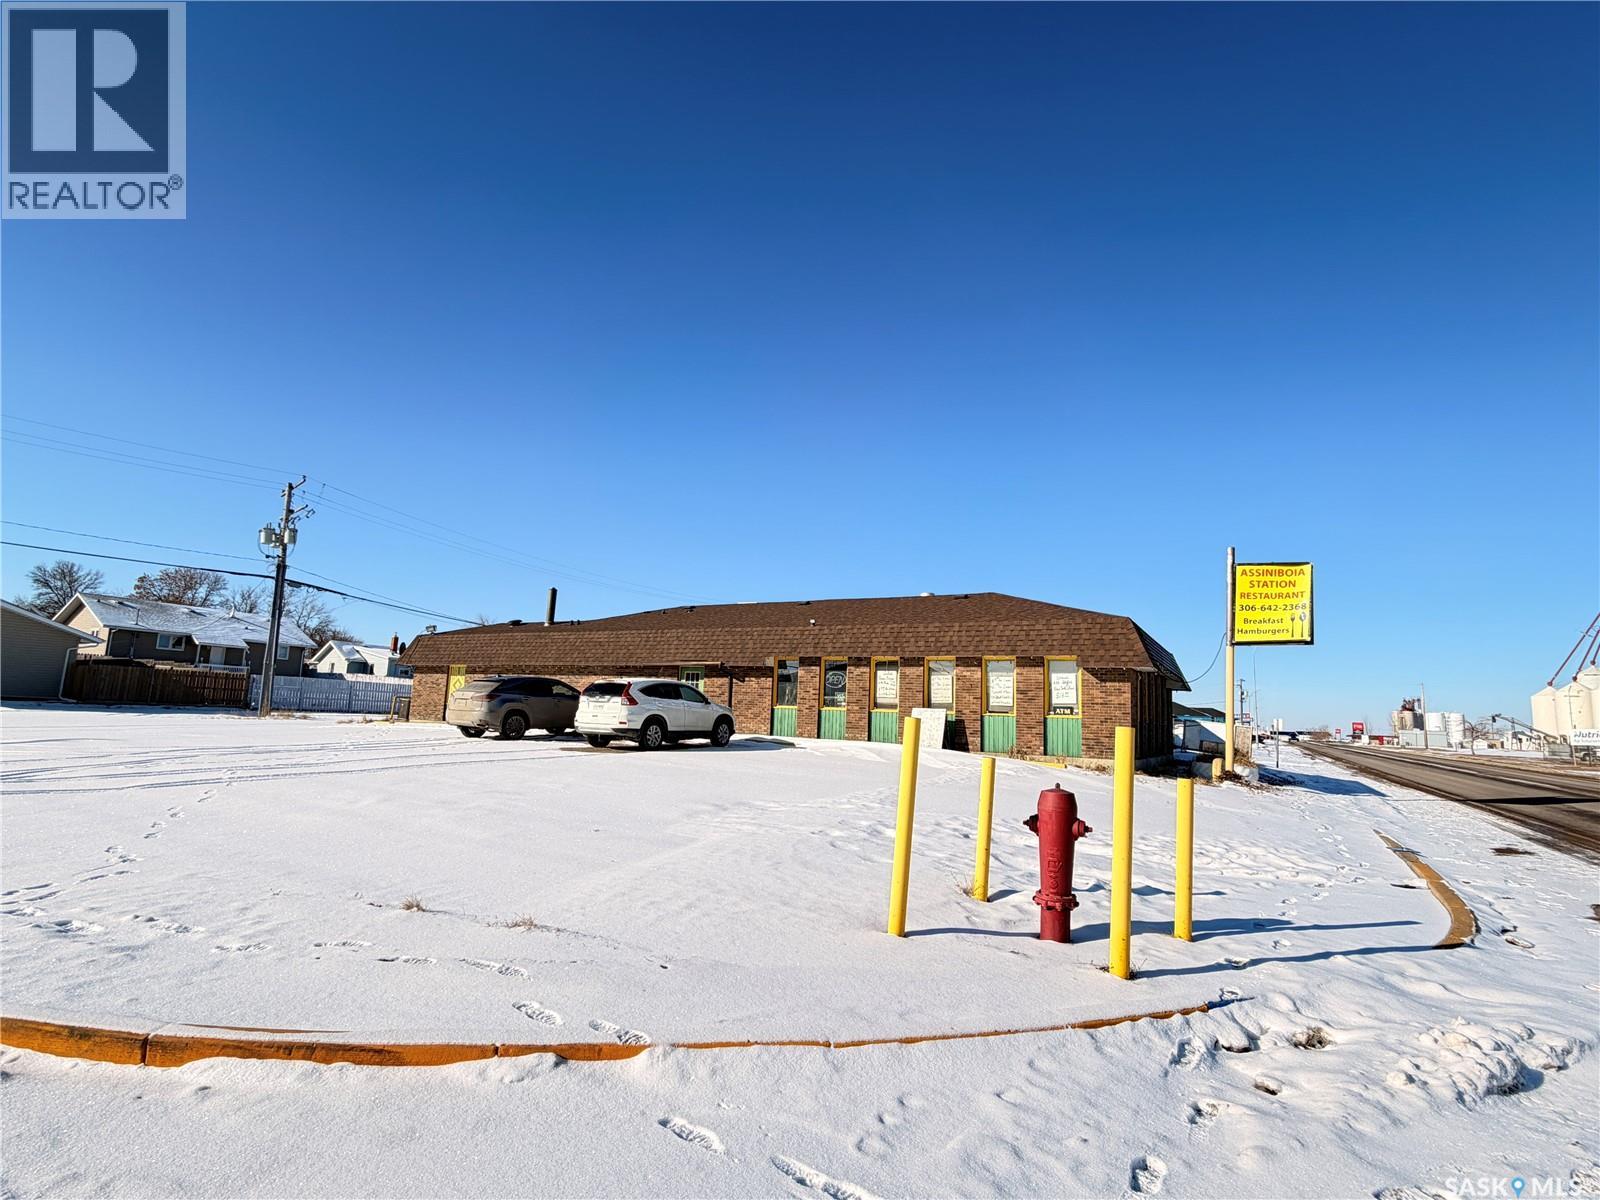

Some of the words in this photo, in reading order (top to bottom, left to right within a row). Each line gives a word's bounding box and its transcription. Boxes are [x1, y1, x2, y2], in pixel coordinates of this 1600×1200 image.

[1241, 569, 1305, 577] ASSINIBOIA
[1249, 580, 1296, 588] STATION
[1240, 591, 1305, 599] RESTAURANT
[1239, 603, 1306, 611] 306-642-2368
[826, 674, 845, 685] OPEN
[1574, 731, 1600, 739] Nutri
